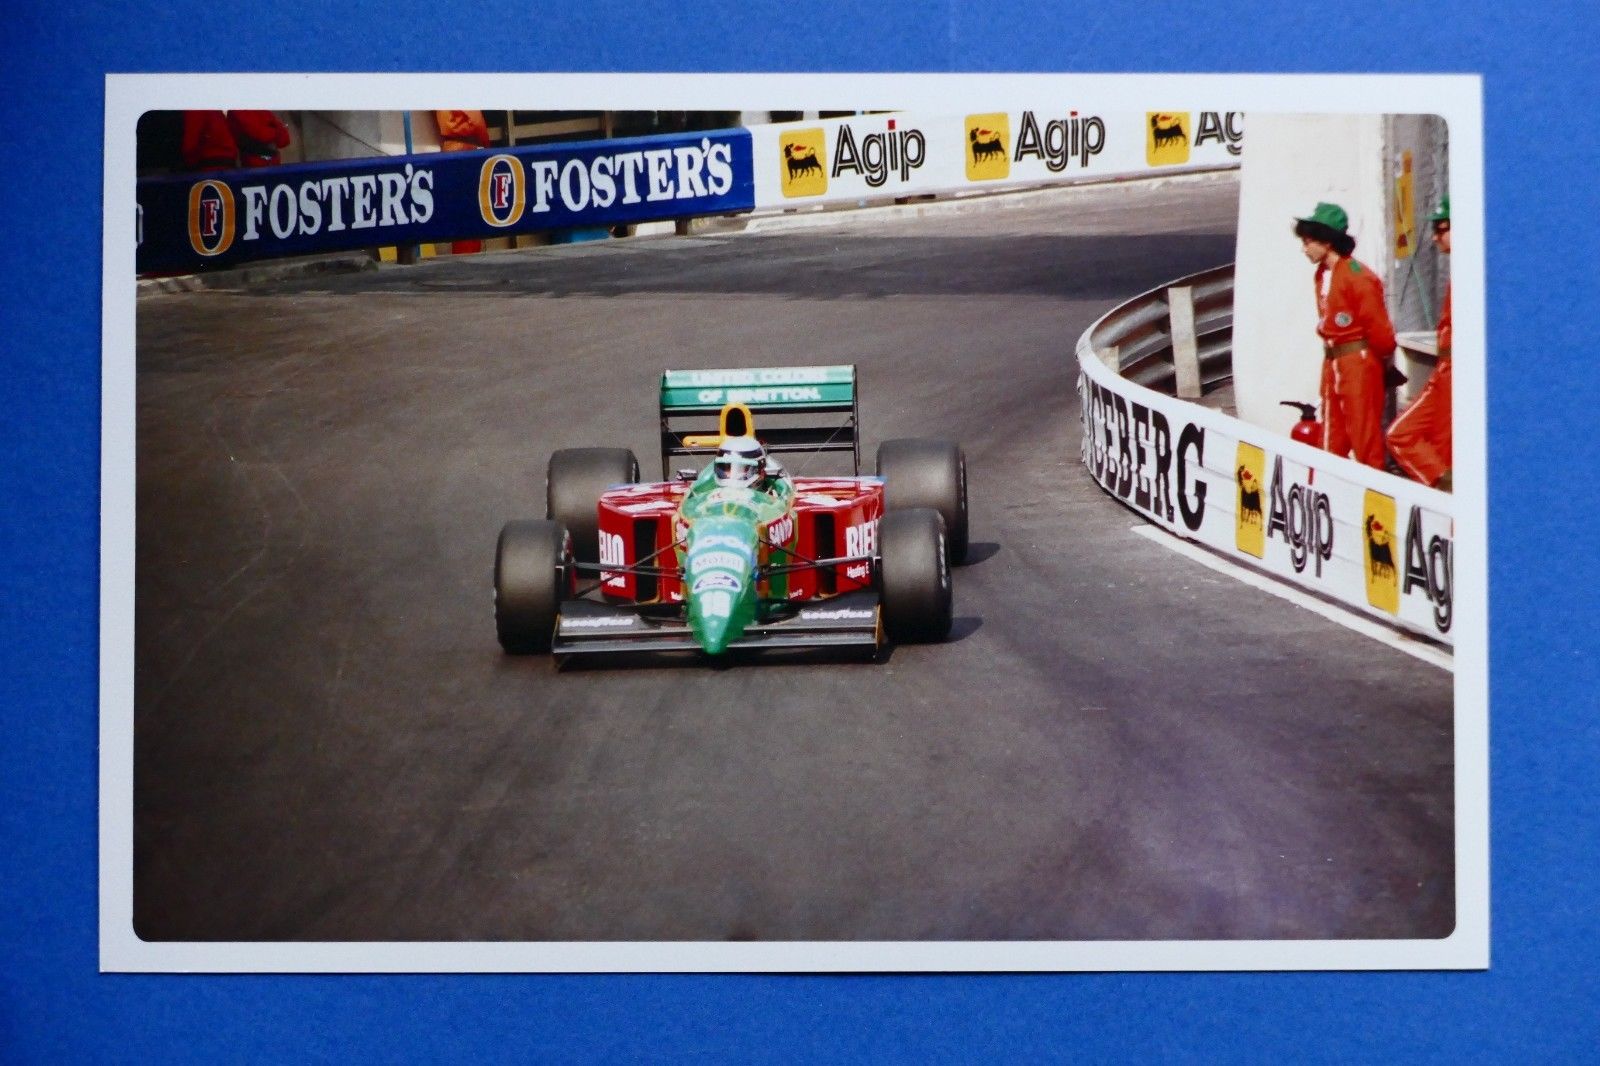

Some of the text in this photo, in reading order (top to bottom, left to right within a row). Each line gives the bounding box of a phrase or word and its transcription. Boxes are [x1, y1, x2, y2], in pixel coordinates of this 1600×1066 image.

[532, 137, 733, 213] FOSTER'S
[832, 119, 926, 187] Agip
[1015, 111, 1106, 172] Agip
[242, 163, 434, 241] FOSTER'S
[1268, 454, 1334, 578] Agip
